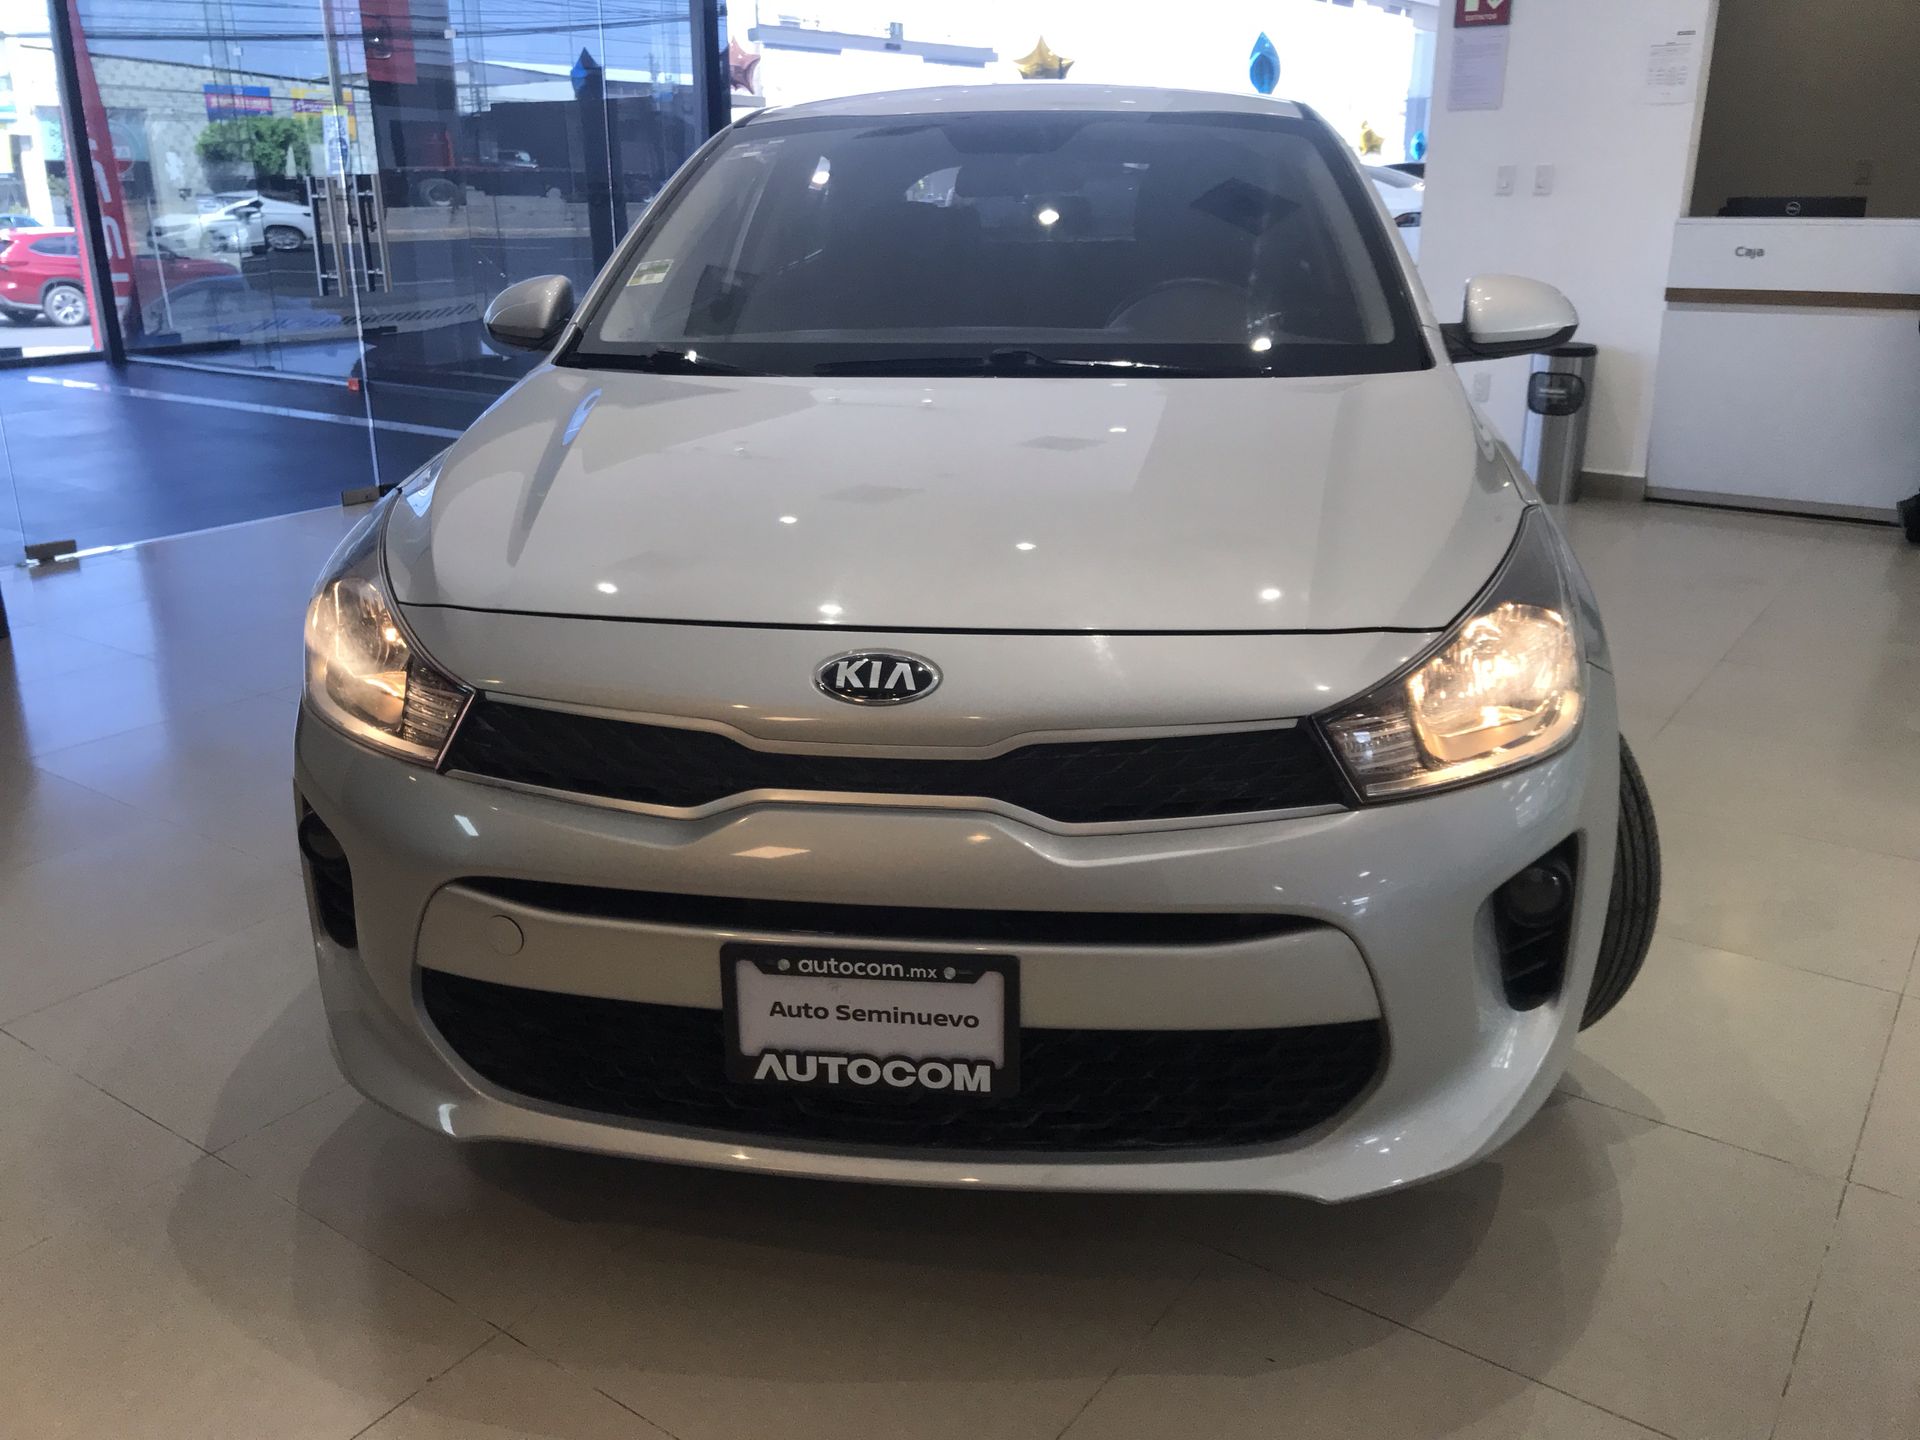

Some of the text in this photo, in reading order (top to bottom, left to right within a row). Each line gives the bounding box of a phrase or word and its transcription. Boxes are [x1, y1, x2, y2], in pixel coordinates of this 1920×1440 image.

[1735, 246, 1765, 259] Caja
[835, 658, 916, 691] KIA
[797, 957, 938, 979] autocom.mx
[769, 1001, 980, 1028] Auto Seminuevo
[753, 1053, 992, 1093] AUTOCOM
